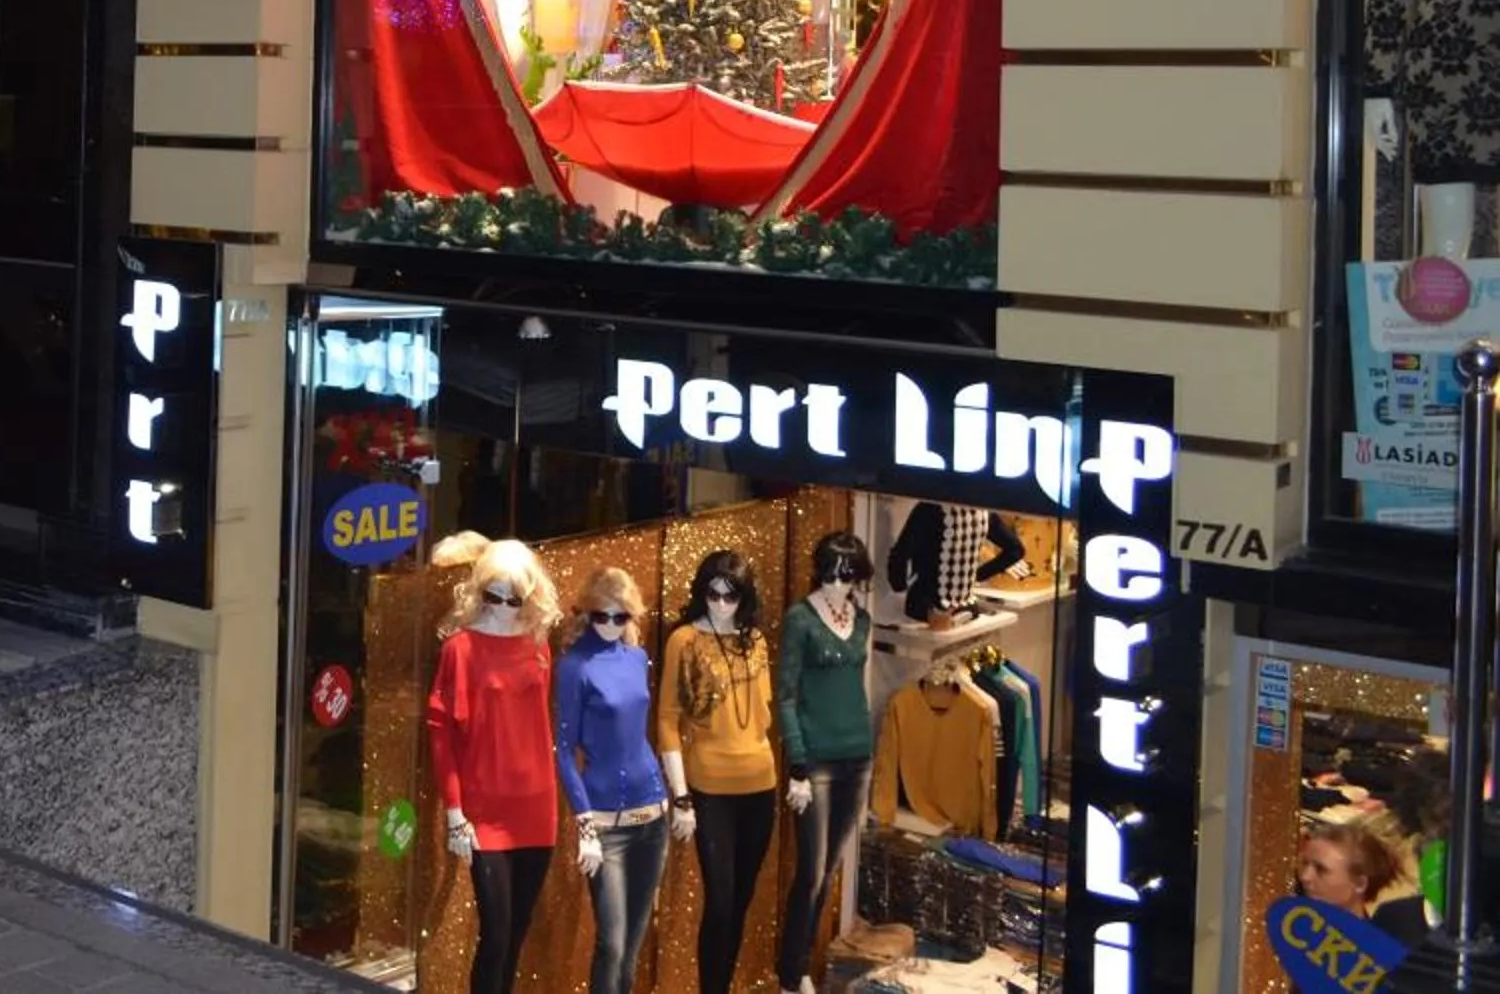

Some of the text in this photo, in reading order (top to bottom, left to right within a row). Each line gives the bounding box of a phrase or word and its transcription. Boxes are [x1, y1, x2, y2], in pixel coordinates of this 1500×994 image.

[602, 358, 846, 457] Pert
[332, 502, 419, 548] SALE
[1177, 520, 1268, 562] 77/A
[1080, 419, 1175, 772] Pert
